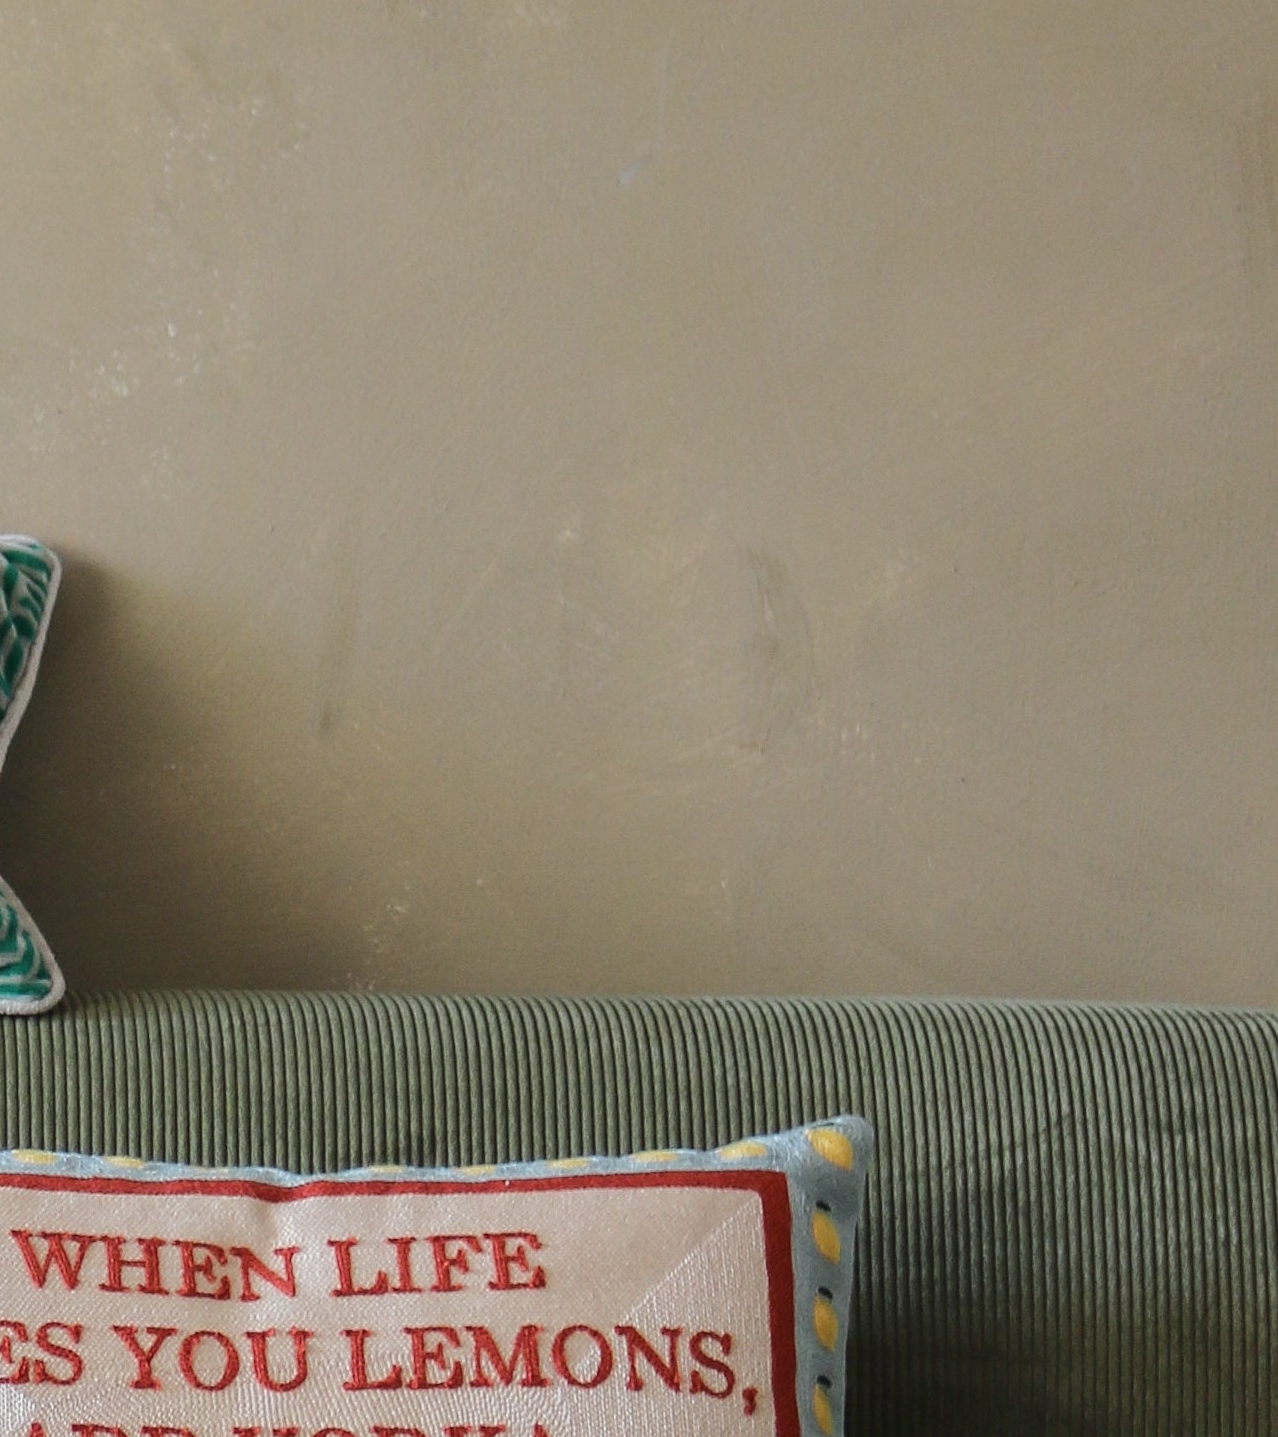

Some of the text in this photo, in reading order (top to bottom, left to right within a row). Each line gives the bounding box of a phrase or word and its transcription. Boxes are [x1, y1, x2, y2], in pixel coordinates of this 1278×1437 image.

[9, 1228, 548, 1303] WHEN LIFE
[110, 1324, 314, 1393] YOU
[341, 1324, 758, 1416] LEMONS,
